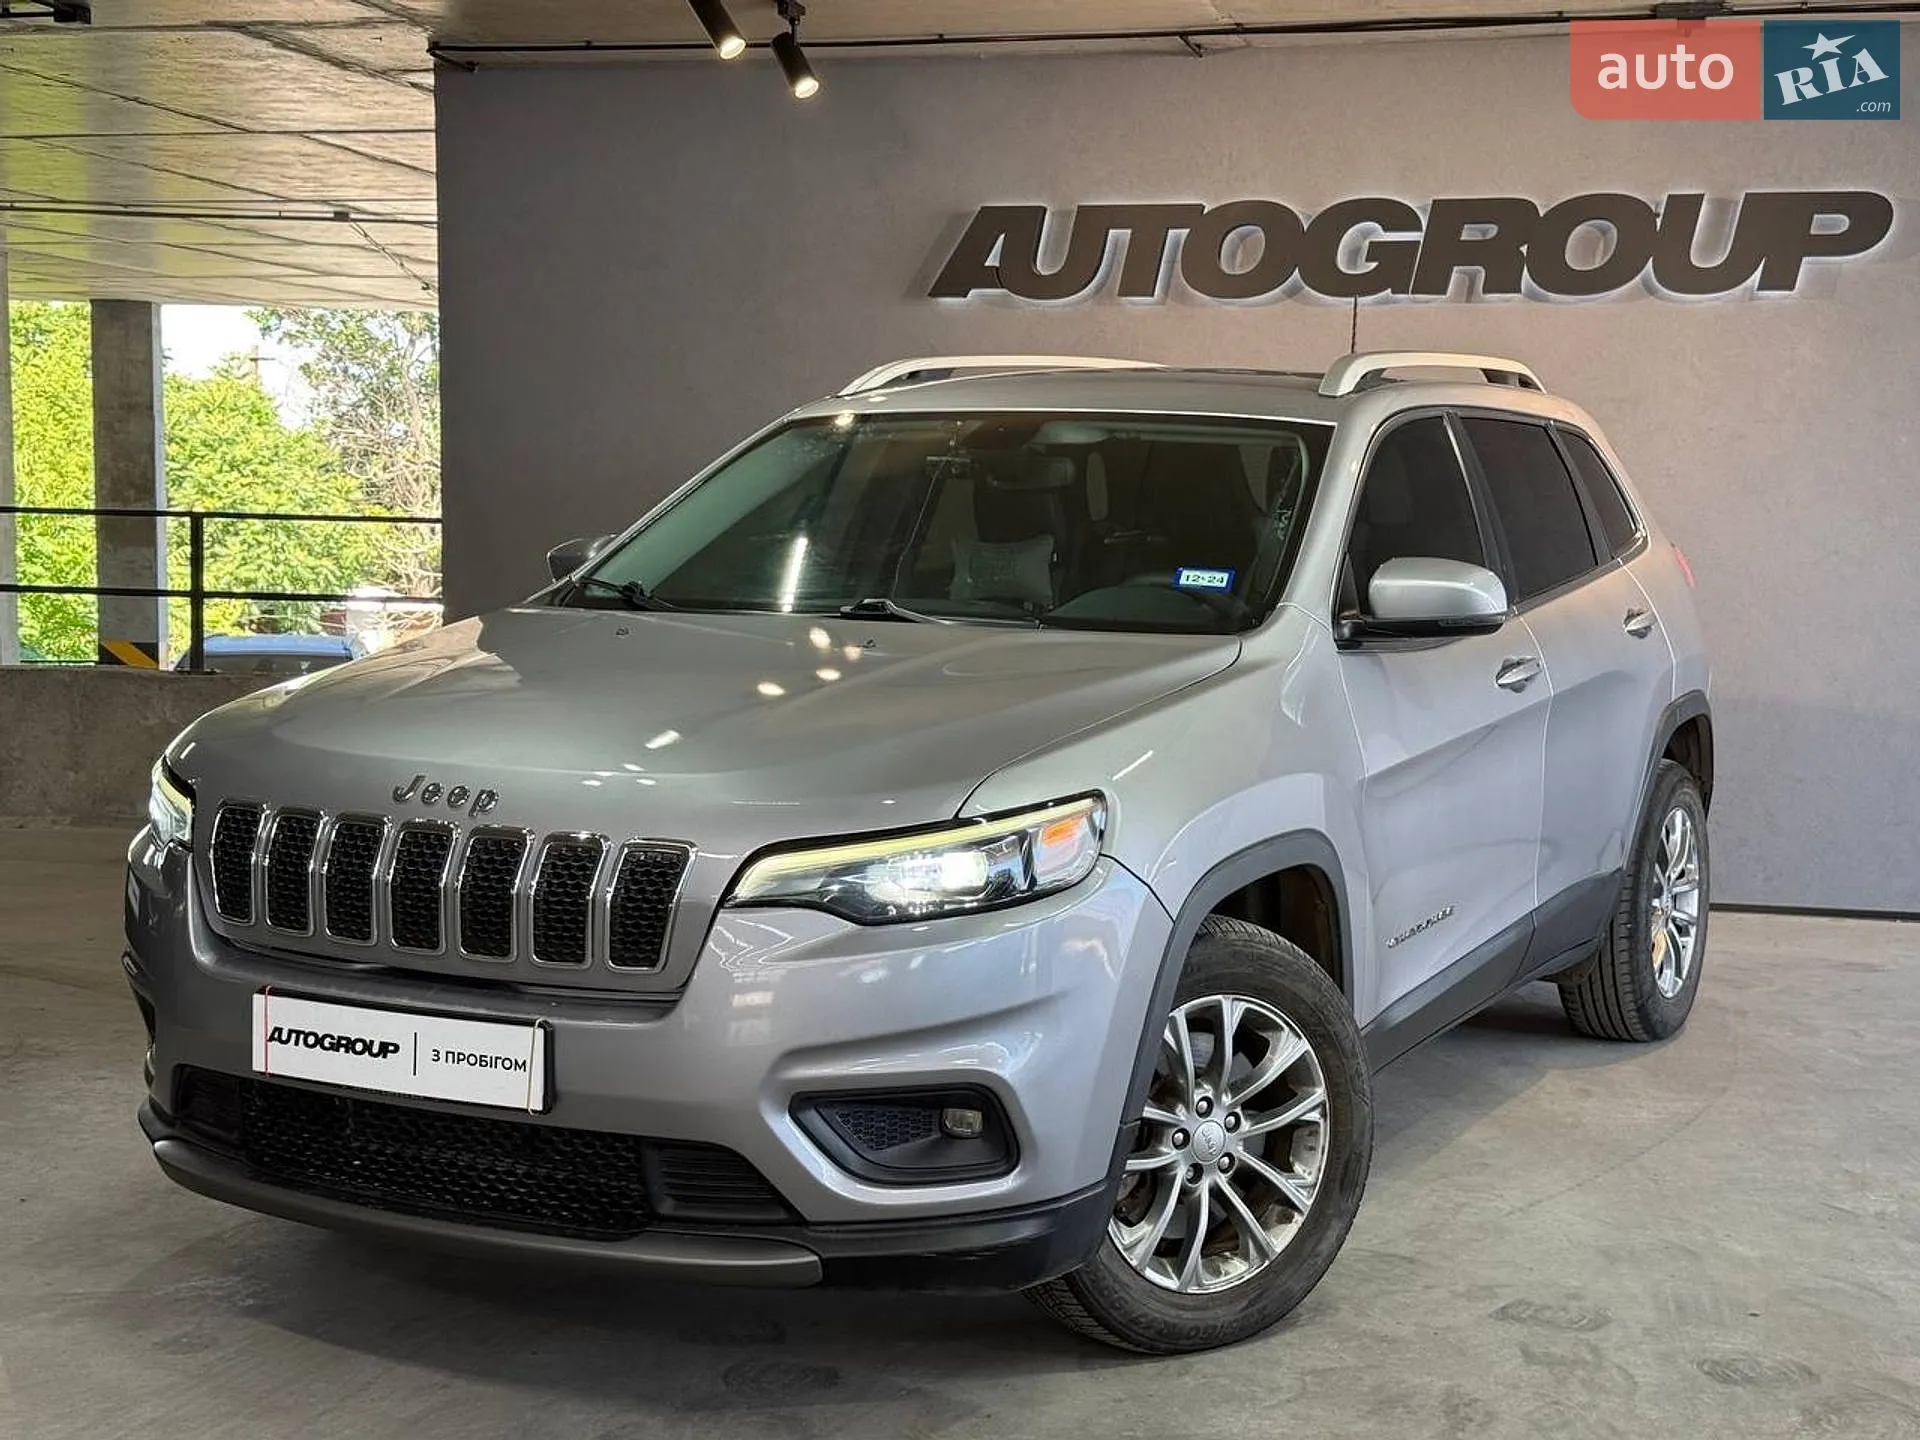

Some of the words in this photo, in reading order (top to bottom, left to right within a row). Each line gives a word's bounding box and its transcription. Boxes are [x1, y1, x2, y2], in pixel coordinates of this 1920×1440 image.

[928, 191, 1894, 300] AUTOGROUP
[392, 774, 499, 817] Jeep
[268, 1026, 400, 1059] AUTOGROUP
[445, 1051, 527, 1073] ПРОБІГОМ
